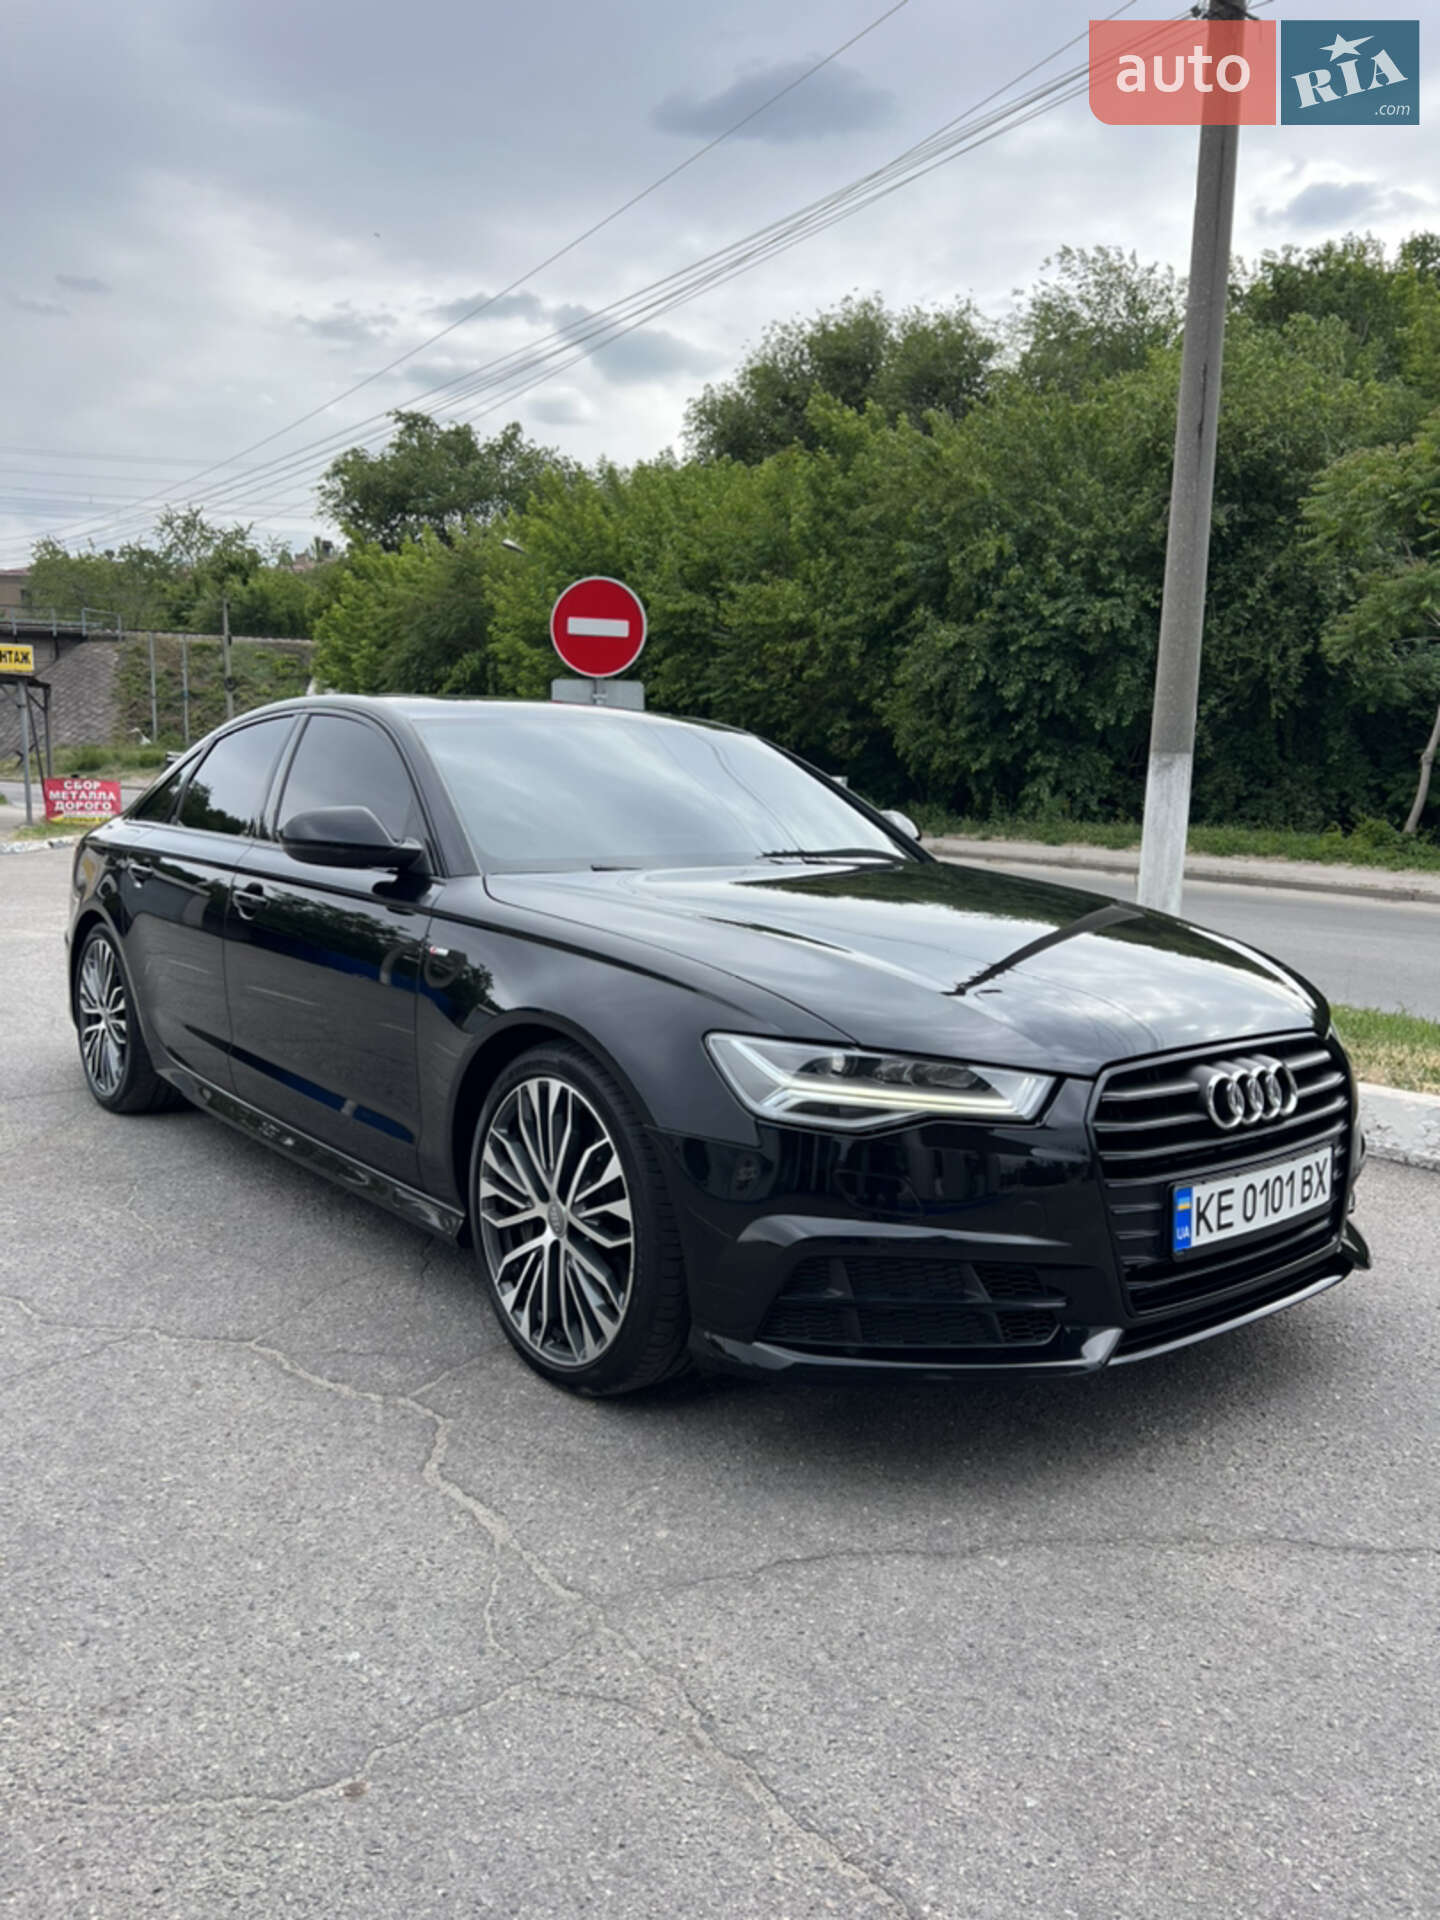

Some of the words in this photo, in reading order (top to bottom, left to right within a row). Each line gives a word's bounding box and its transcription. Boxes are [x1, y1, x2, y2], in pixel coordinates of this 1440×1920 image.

[63, 779, 101, 791] СБОР
[49, 789, 116, 801] МЕТАЛЛА
[54, 800, 112, 812] ДОРОГО
[1196, 1189, 1234, 1237] KE
[1242, 1171, 1295, 1222] 0101
[1301, 1157, 1329, 1203] BX
[1176, 1225, 1191, 1241] UA
